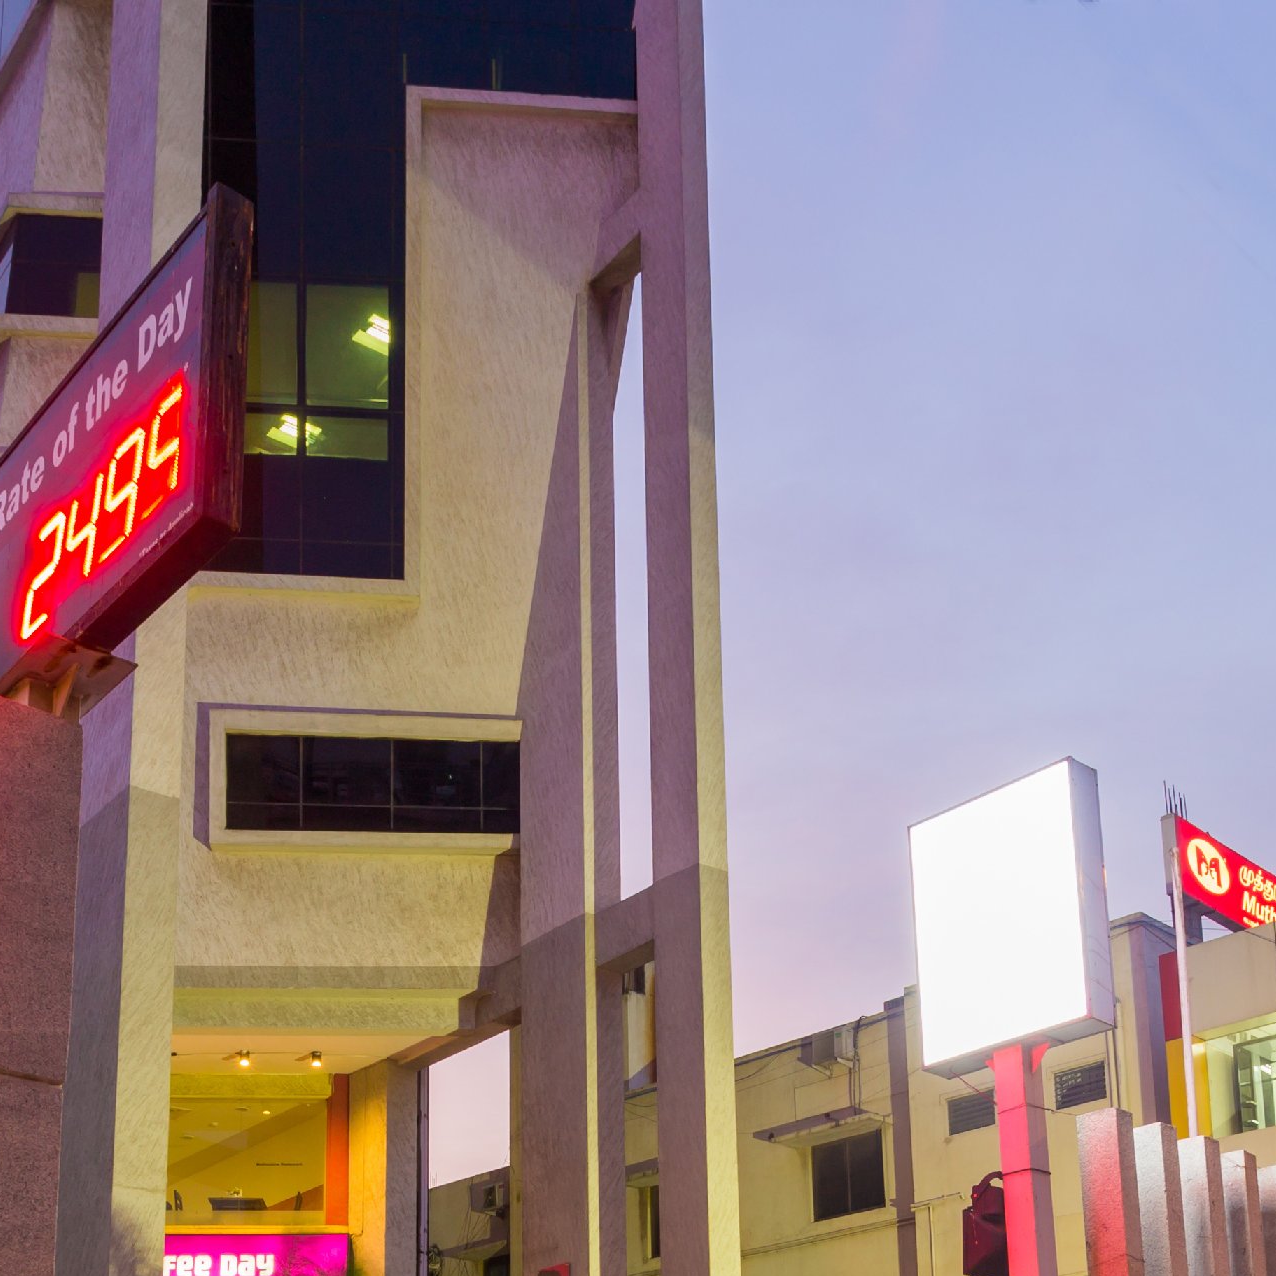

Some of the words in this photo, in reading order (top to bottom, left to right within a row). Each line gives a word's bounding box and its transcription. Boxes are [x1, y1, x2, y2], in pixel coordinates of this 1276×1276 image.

[52, 402, 79, 468] of
[86, 358, 128, 432] the
[137, 277, 193, 373] Day
[21, 382, 183, 640] 2495
